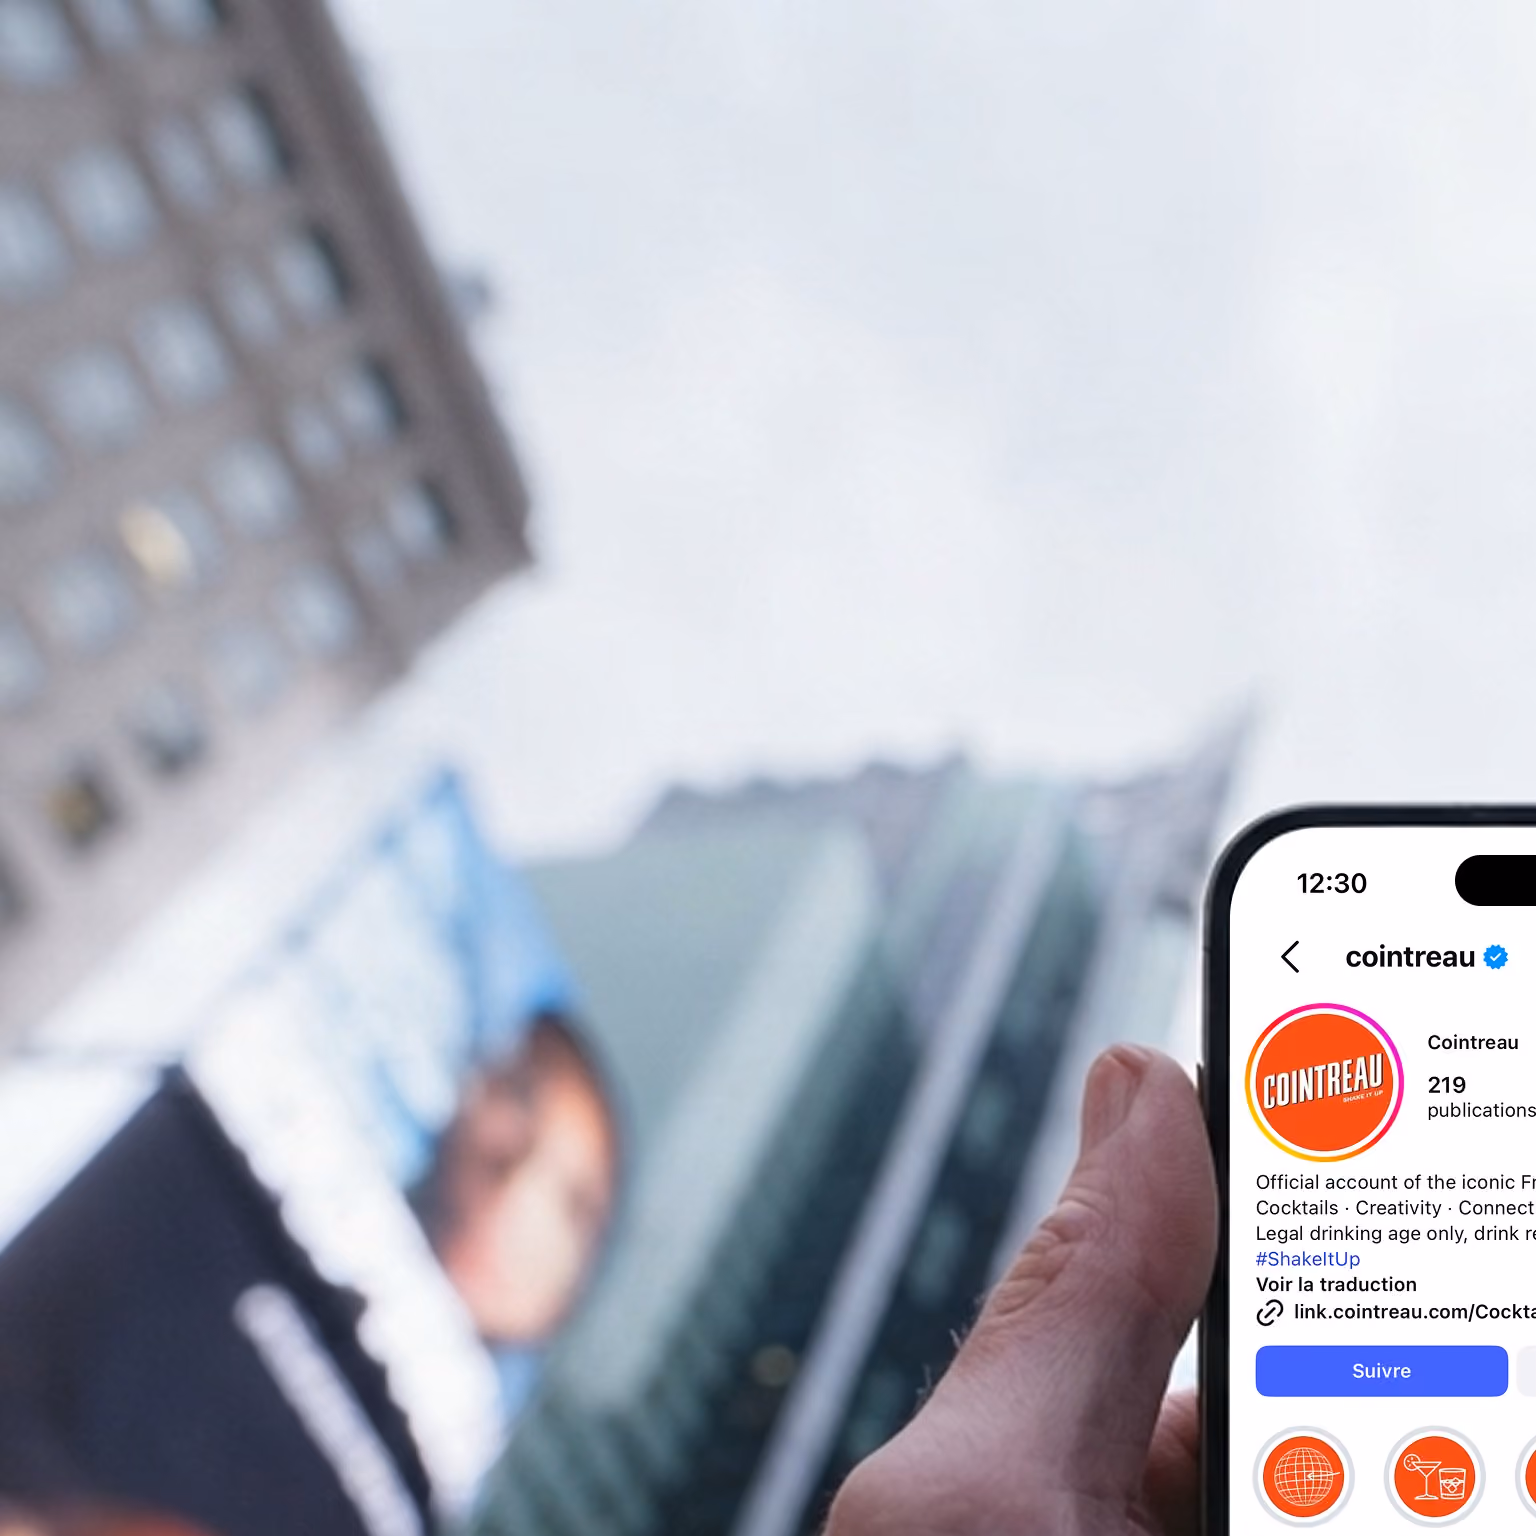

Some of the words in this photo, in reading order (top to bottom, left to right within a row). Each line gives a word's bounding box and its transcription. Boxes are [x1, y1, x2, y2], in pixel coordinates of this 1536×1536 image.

[1297, 873, 1367, 894] 12:30
[1345, 944, 1475, 968] cointreau
[1427, 1033, 1519, 1050] Cointreau
[1263, 1053, 1383, 1109] COINTREAU
[1428, 1076, 1466, 1094] 219
[1428, 1101, 1536, 1121] publications
[1256, 1173, 1319, 1190] Official
[1325, 1175, 1398, 1190] account
[1403, 1173, 1422, 1190] of
[1426, 1174, 1457, 1190] the
[1462, 1173, 1516, 1190] iconic
[1256, 1199, 1339, 1216] Cocktails
[1355, 1199, 1442, 1219] Creativity
[1256, 1225, 1303, 1245] Legal
[1309, 1225, 1382, 1245] drinking
[1388, 1229, 1421, 1245] age
[1426, 1225, 1468, 1245] only,
[1474, 1225, 1520, 1241] drink
[1255, 1250, 1361, 1270] #ShakeItUp
[1256, 1276, 1293, 1292] Voir
[1298, 1276, 1314, 1292] la
[1320, 1275, 1417, 1292] traduction
[1352, 1362, 1412, 1379] Suivre
